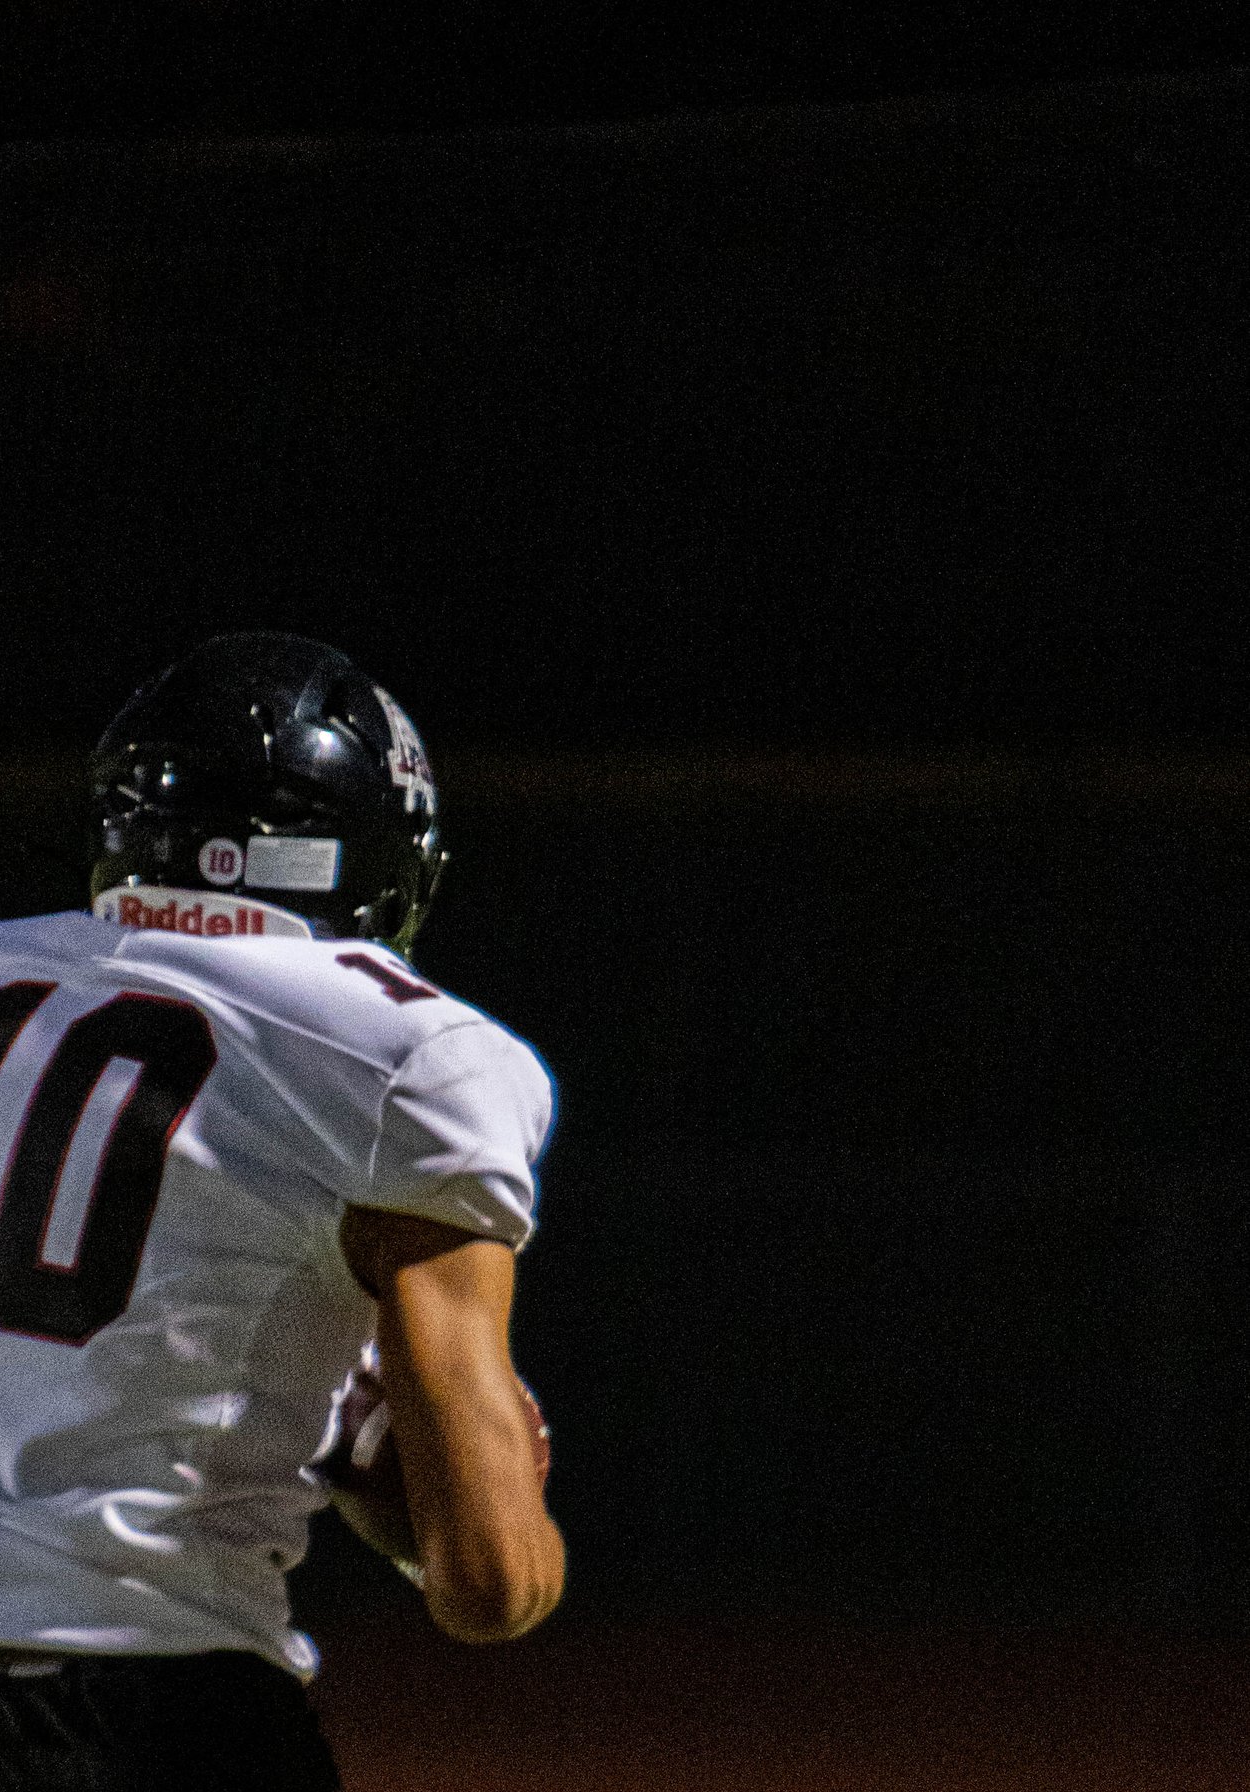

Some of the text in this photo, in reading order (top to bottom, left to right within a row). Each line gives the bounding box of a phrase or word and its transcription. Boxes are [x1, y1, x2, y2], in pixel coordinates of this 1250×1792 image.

[209, 848, 235, 875] 10
[118, 895, 264, 936] Riddell
[334, 952, 444, 1005] 1
